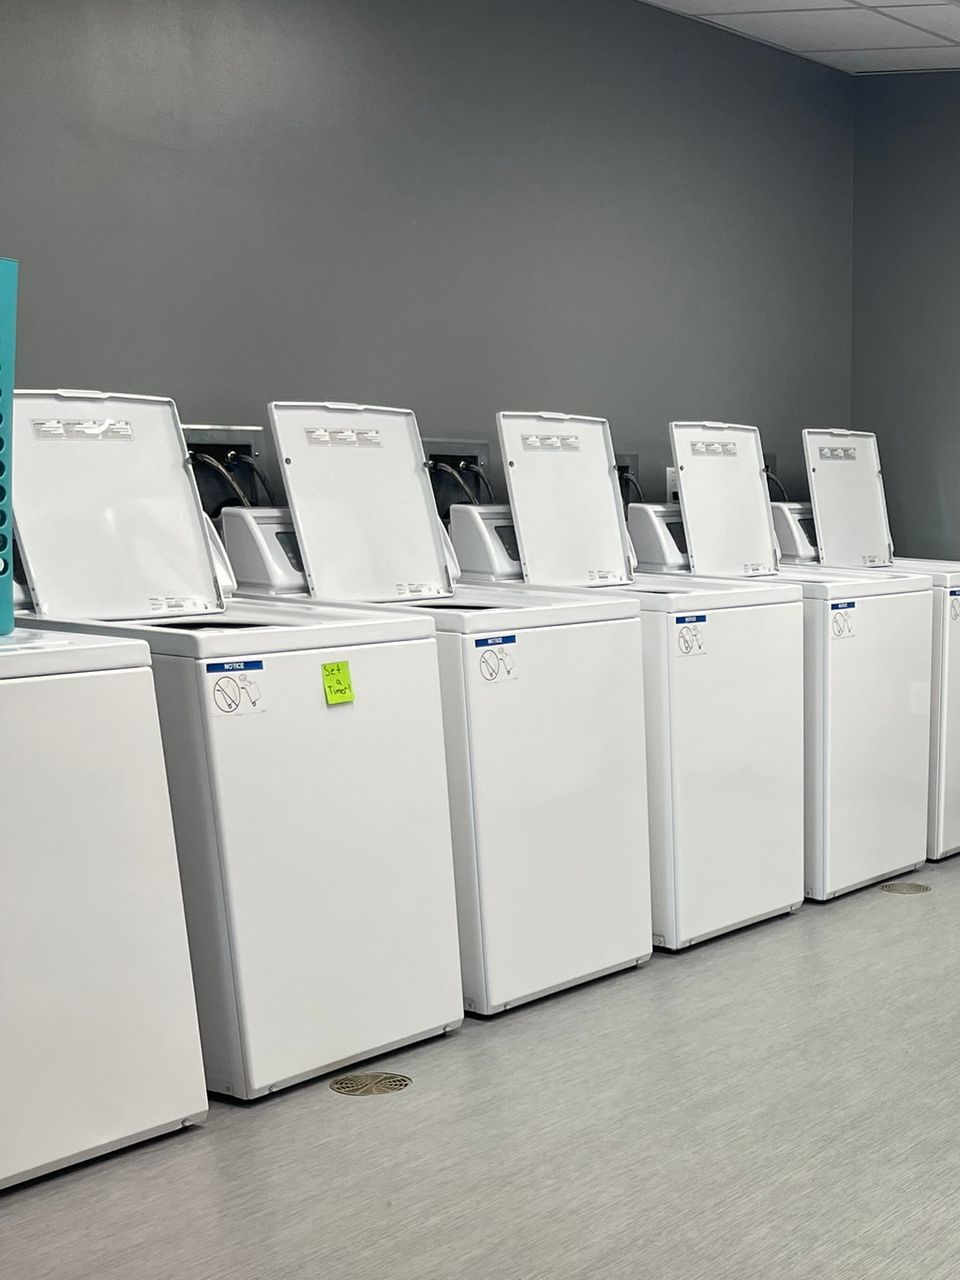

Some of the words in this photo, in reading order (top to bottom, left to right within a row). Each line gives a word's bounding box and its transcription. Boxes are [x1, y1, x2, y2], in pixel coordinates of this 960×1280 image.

[224, 662, 245, 670] NOTICE
[323, 664, 341, 677] Set
[335, 678, 342, 687] a
